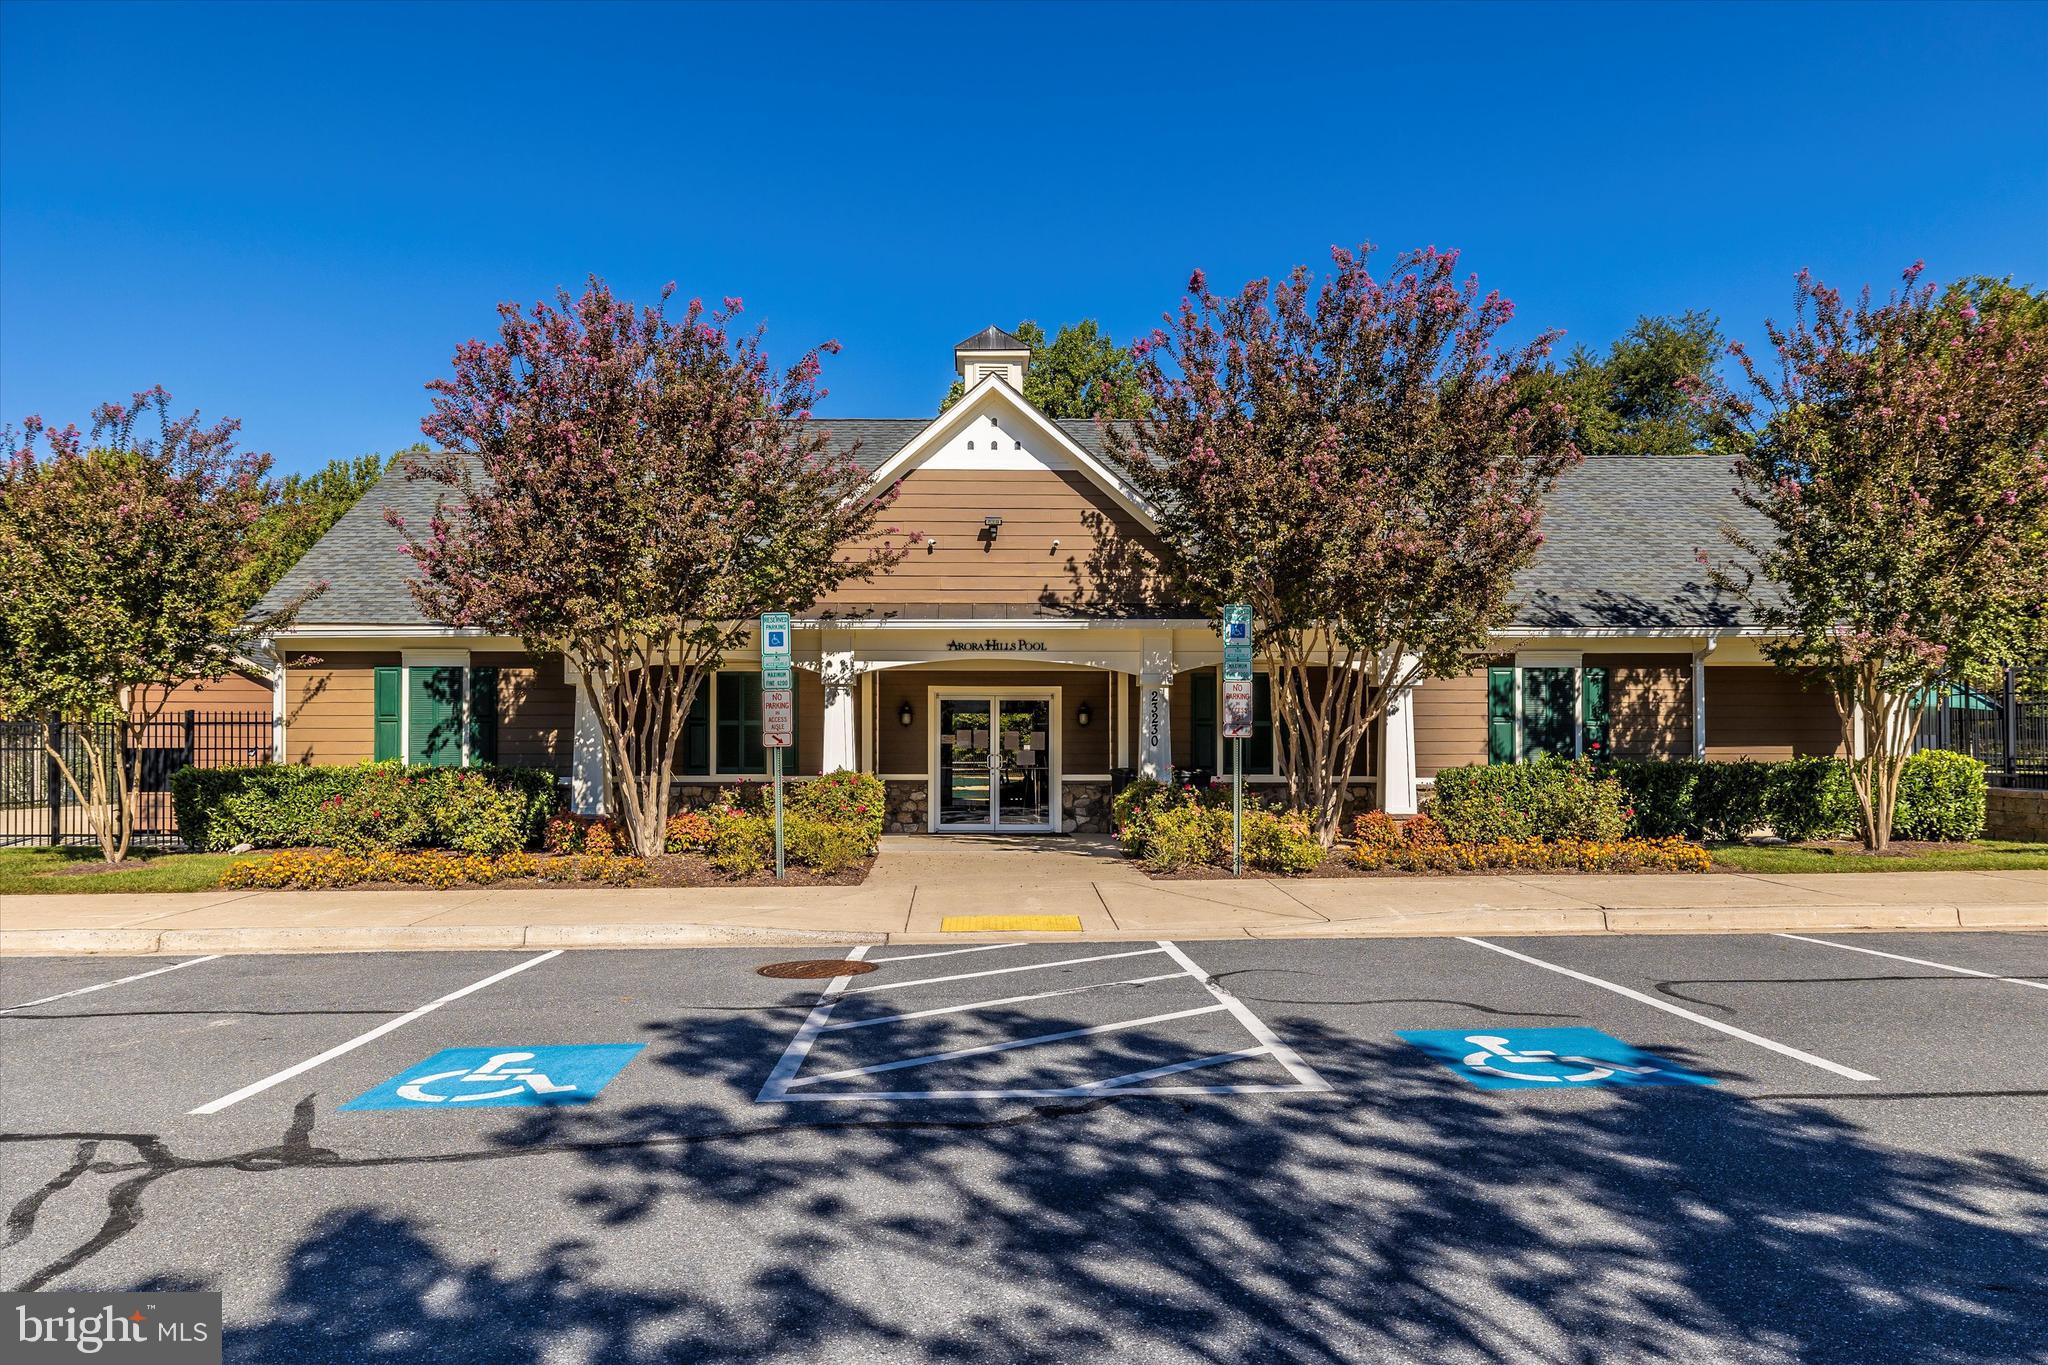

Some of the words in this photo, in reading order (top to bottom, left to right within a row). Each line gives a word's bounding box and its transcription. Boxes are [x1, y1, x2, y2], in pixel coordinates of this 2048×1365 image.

[946, 639, 984, 651] ARORA
[984, 639, 1017, 651] HILLS
[1018, 639, 1047, 651] POOL
[1232, 684, 1243, 692] NO
[772, 693, 783, 701] NO
[765, 702, 790, 710] PARKING
[1151, 690, 1160, 747] 23230
